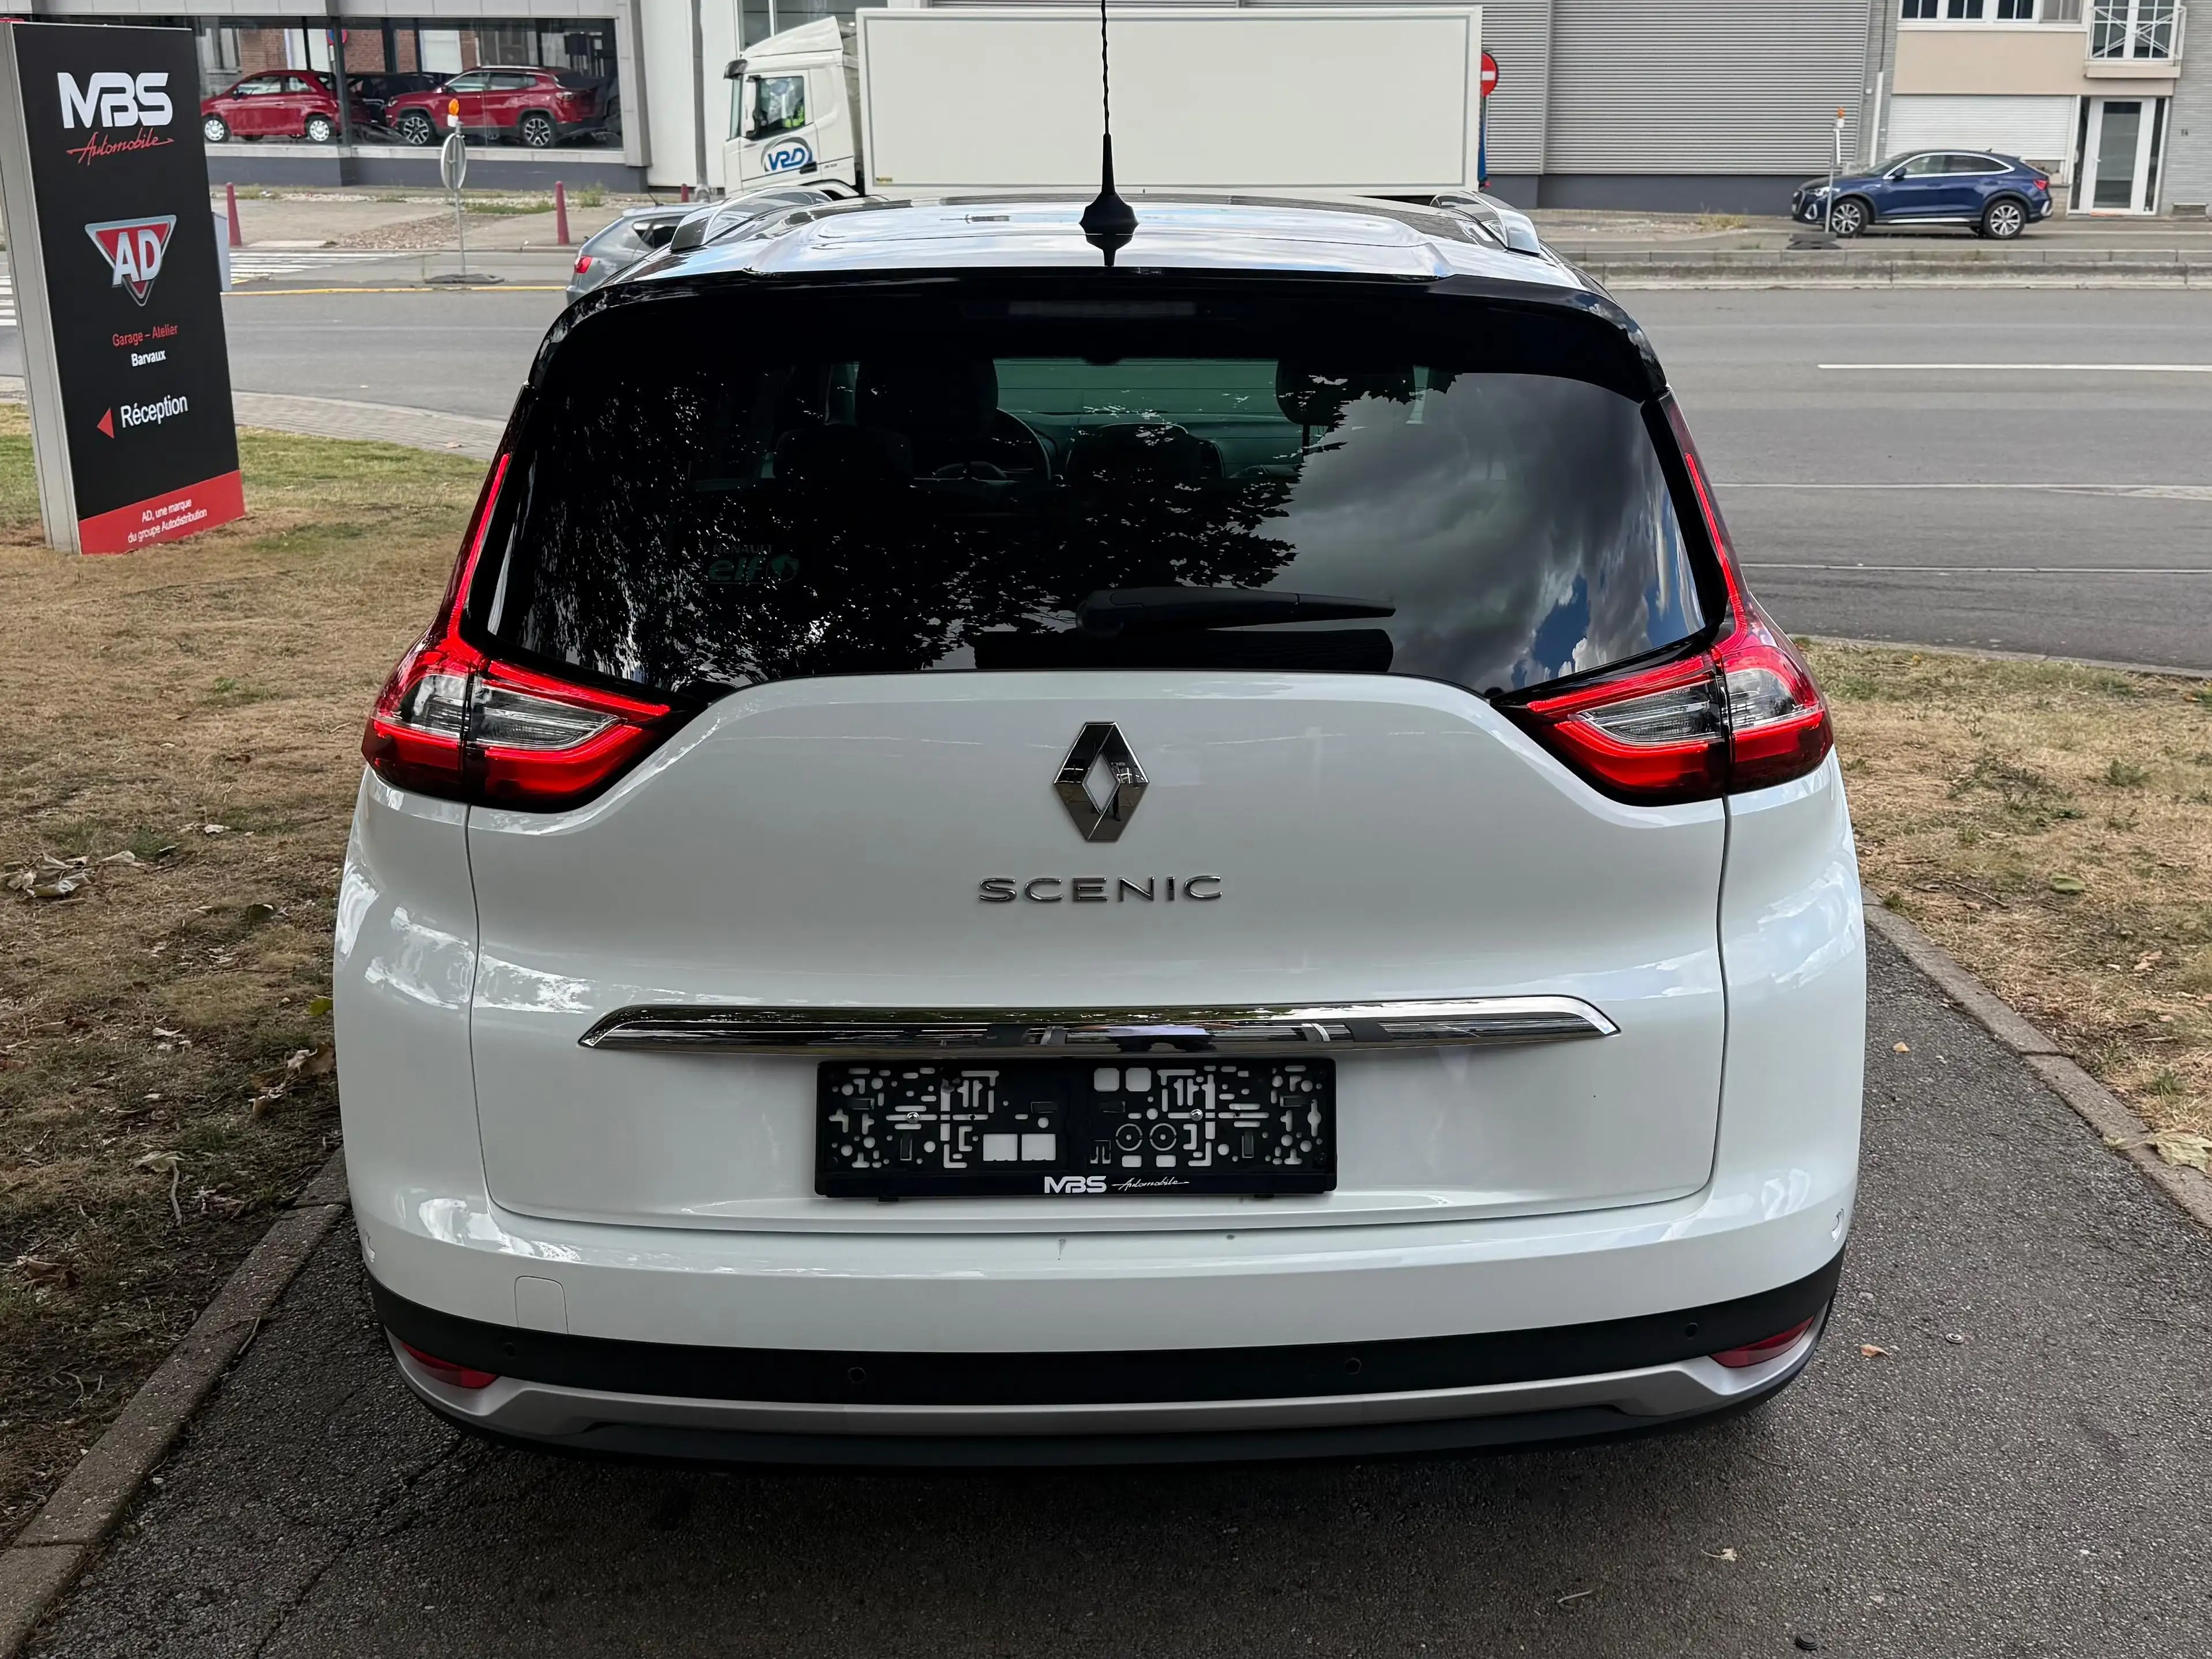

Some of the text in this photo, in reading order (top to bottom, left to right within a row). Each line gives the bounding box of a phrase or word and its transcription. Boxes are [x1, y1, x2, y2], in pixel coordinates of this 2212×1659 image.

[58, 73, 173, 128] MBS
[66, 127, 175, 166] Automobile
[768, 147, 806, 171] VRD
[112, 230, 162, 286] AD
[112, 332, 143, 346] Garage
[152, 323, 179, 339] Atelier
[131, 350, 166, 367] Barvaux
[120, 394, 188, 428] Réception
[142, 499, 192, 522] AD, une marque
[128, 509, 207, 543] du groupe Autodistribution
[713, 544, 775, 554] RENAULT
[708, 555, 763, 581] elf
[979, 876, 1223, 903] SCENIC
[1044, 1175, 1189, 1194] MBS Automobile
